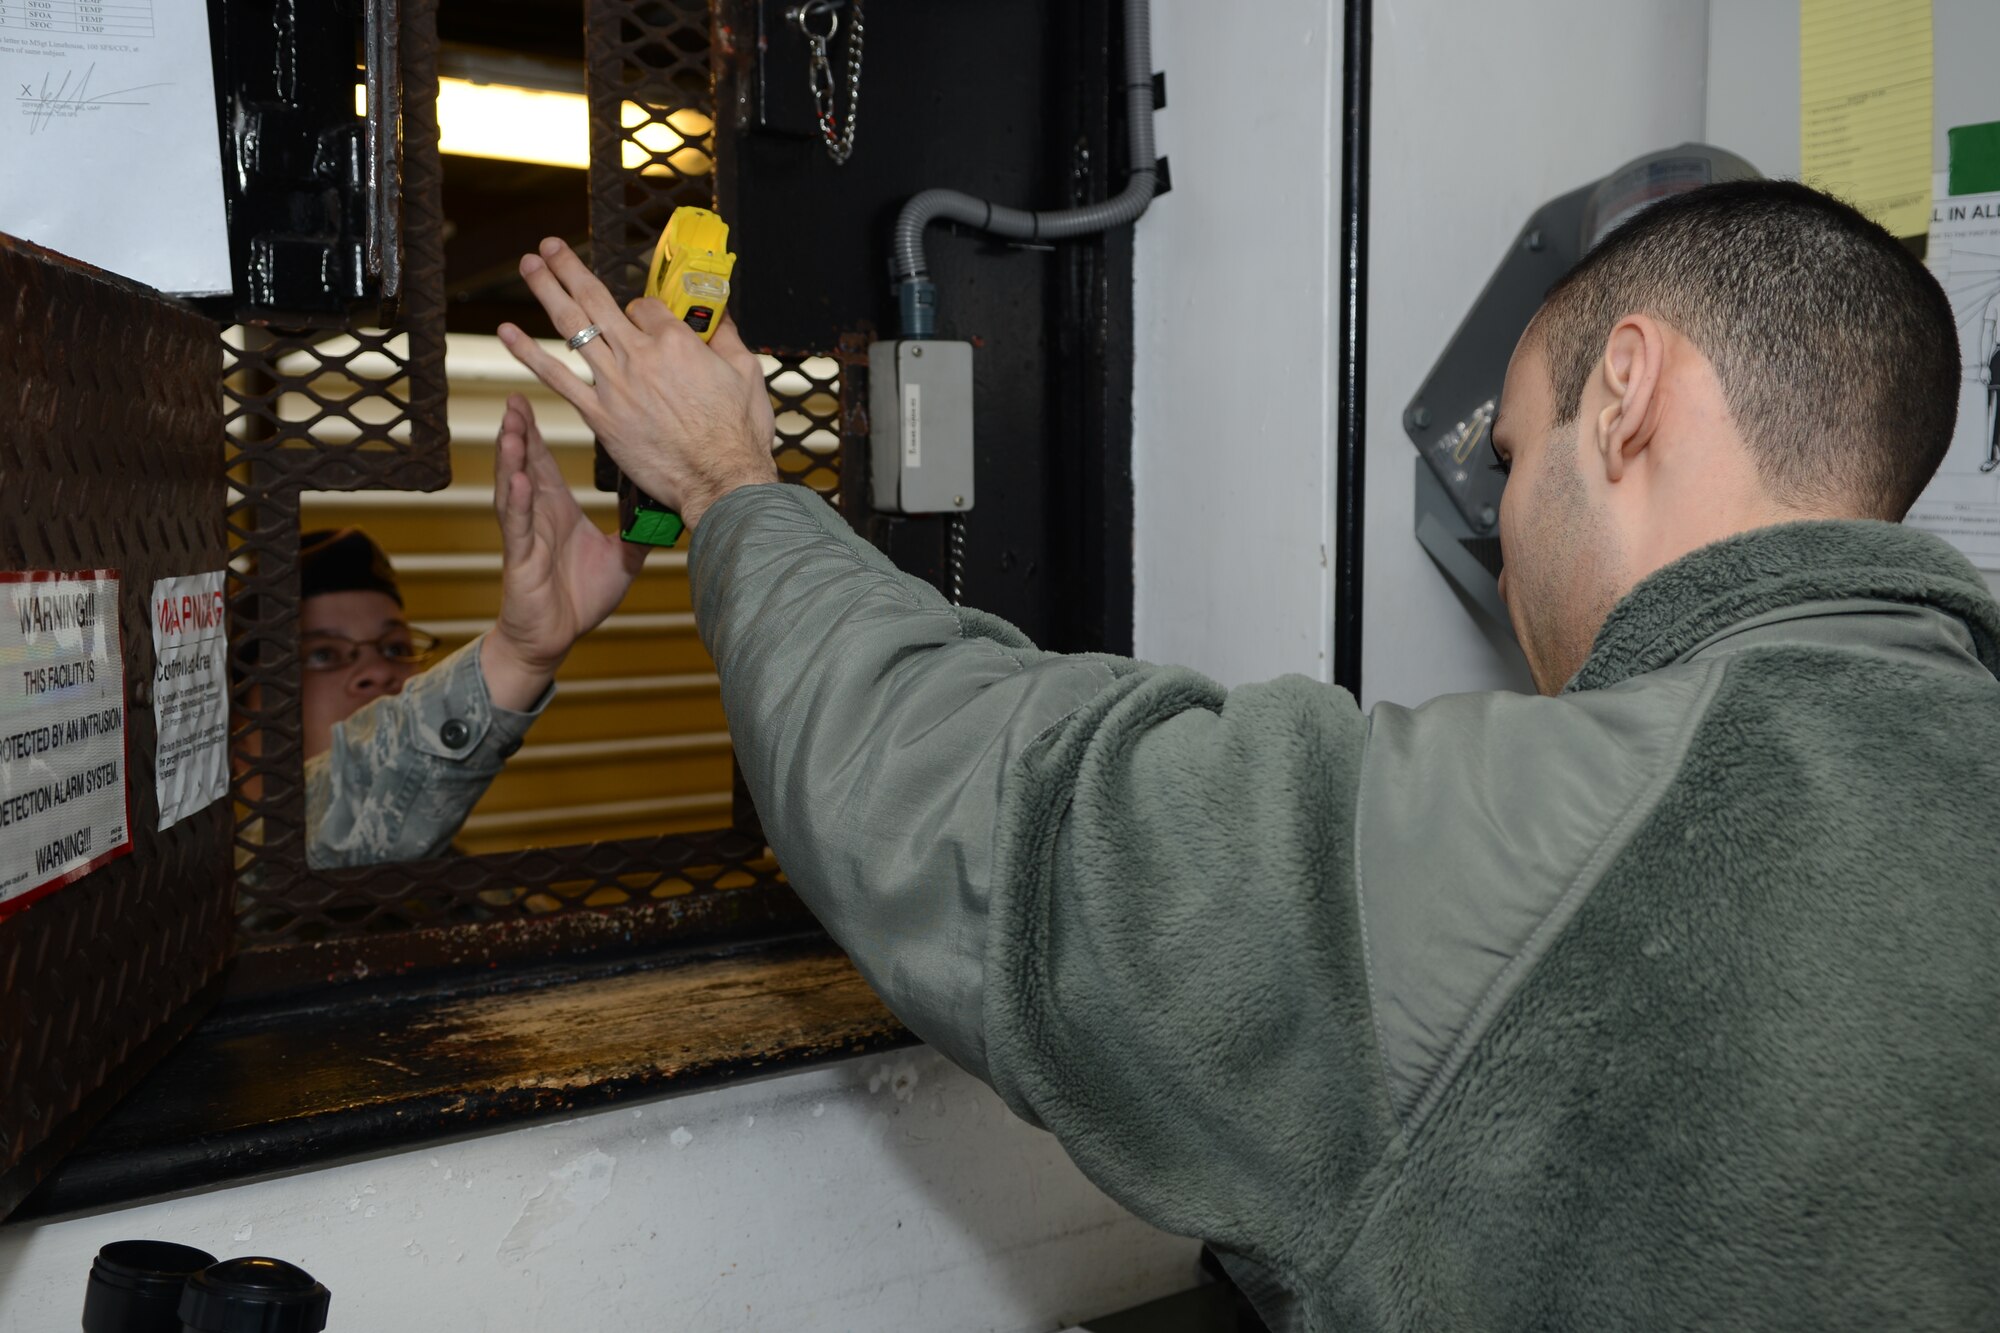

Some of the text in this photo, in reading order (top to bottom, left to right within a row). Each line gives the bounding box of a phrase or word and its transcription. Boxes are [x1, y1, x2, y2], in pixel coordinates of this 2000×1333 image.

[30, 21, 53, 29] SFOC
[81, 25, 105, 33] TEMP
[80, 15, 104, 23] TEMP
[1949, 206, 1966, 220] IN
[18, 593, 95, 635] WARNING!!!
[24, 659, 95, 696] THIS FACILITY IS
[52, 722, 65, 748] BY
[66, 718, 79, 744] AN
[80, 706, 122, 740] INTRUSION
[54, 773, 85, 807] ALARM
[86, 761, 119, 794] SYSTEM.
[35, 826, 92, 876] WARNING!!!
